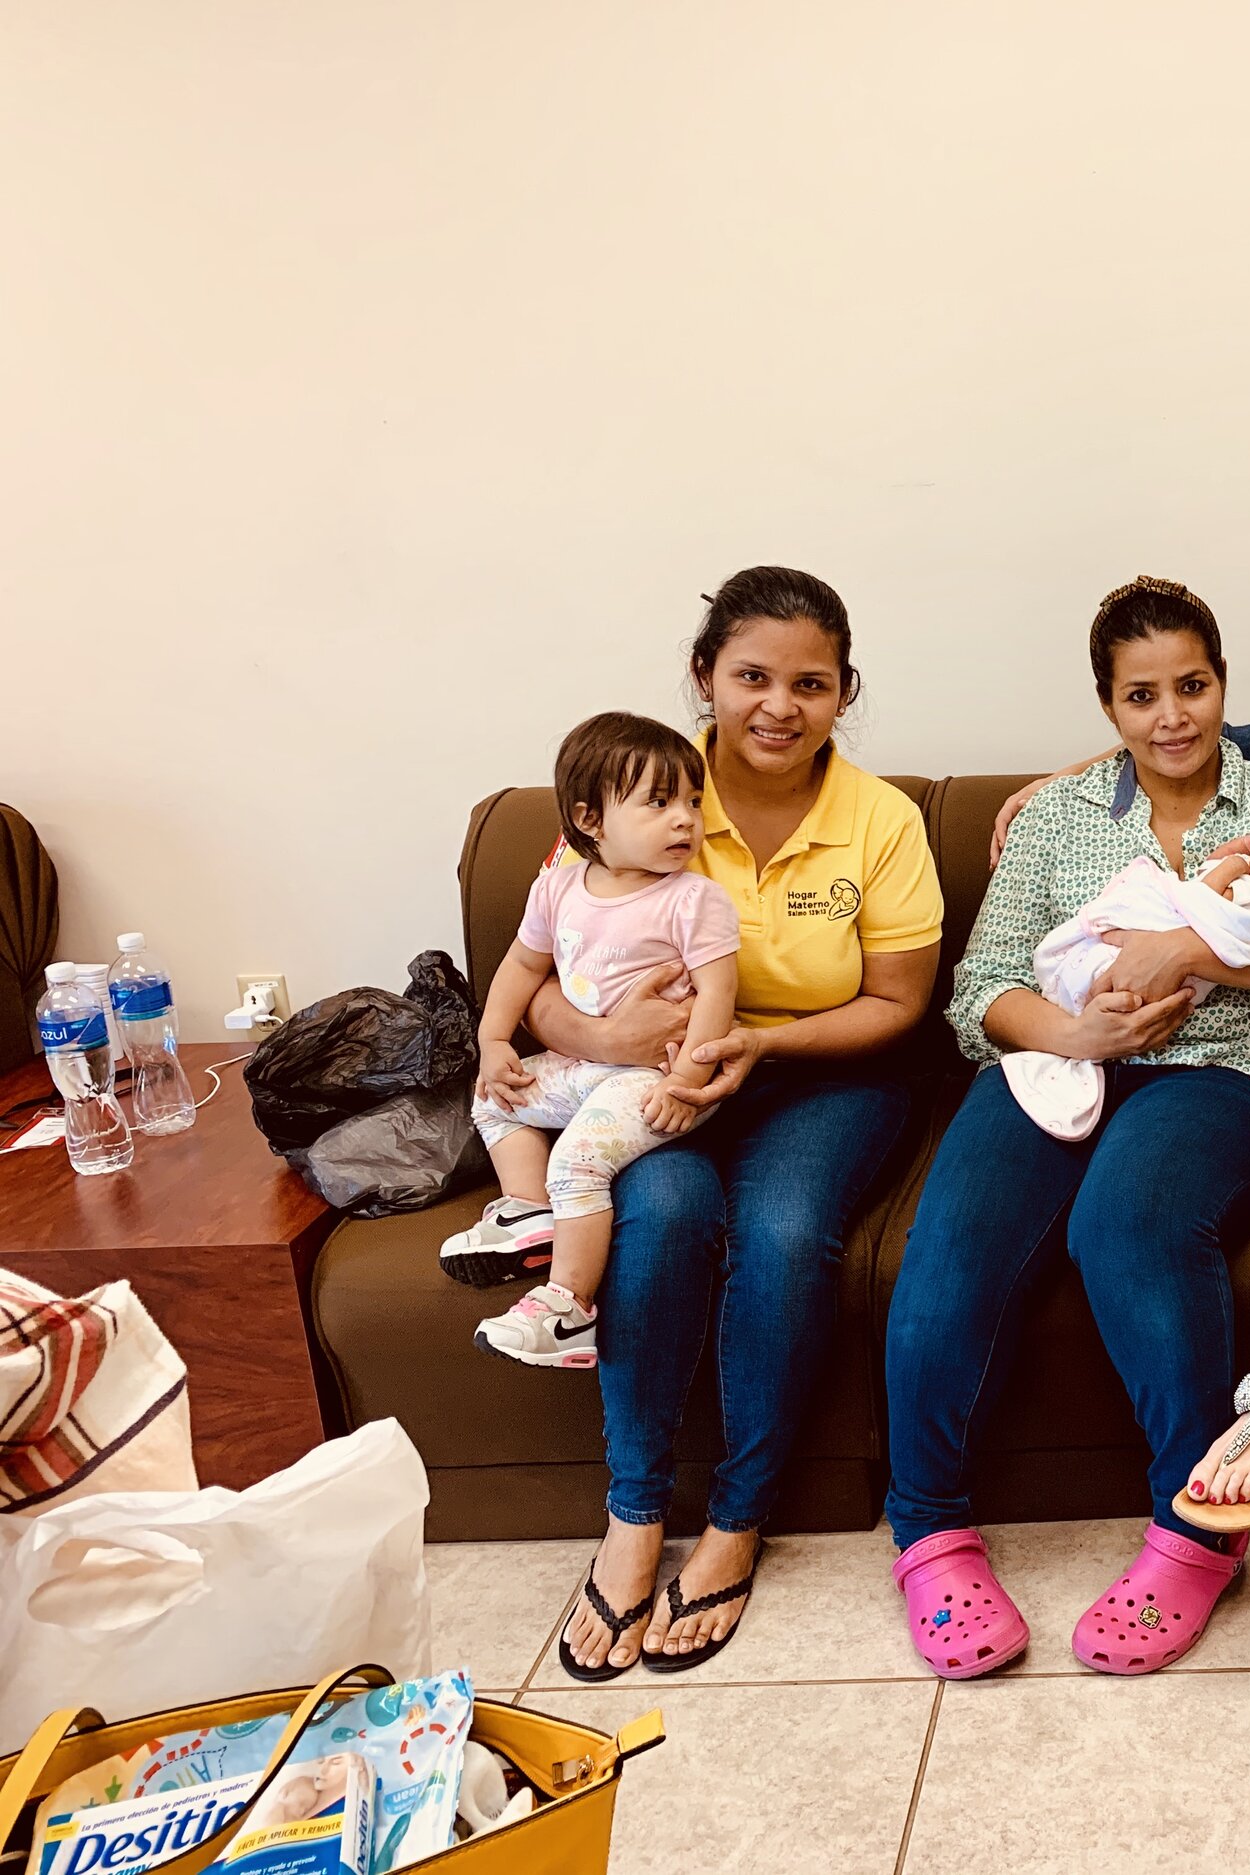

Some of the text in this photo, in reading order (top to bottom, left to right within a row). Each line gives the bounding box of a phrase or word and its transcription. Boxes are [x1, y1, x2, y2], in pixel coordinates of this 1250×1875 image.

[787, 891, 817, 901] Hogar
[788, 901, 830, 910] Materno
[41, 1027, 67, 1040] azul
[92, 1816, 125, 1830] primera
[160, 1802, 171, 1811] de
[172, 1792, 210, 1809] pediatras
[65, 1799, 248, 1875] Desitin
[257, 1834, 268, 1845] DE
[268, 1828, 298, 1839] APLICAR
[301, 1827, 307, 1835] Y
[307, 1821, 342, 1834] REMOVER
[357, 1800, 368, 1875] Desitin
